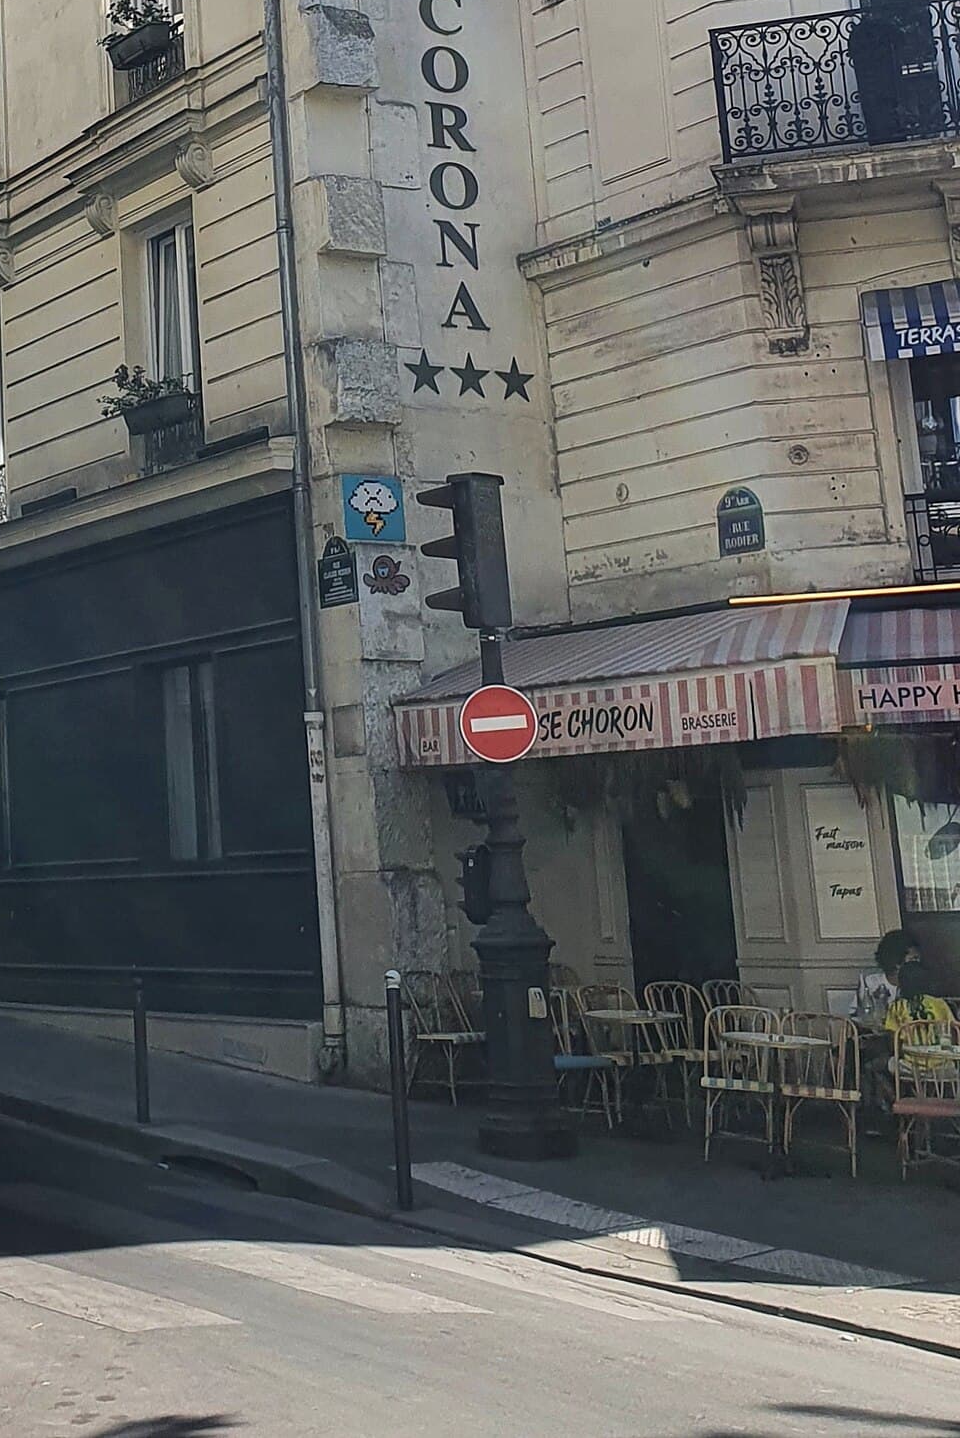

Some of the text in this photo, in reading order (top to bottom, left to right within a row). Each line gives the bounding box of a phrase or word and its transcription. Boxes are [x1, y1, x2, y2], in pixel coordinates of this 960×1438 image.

[732, 520, 751, 534] RUE
[724, 533, 760, 550] RODIER
[858, 685, 942, 710] HAPPY
[567, 700, 654, 739] CHORON
[681, 712, 737, 731] BRASSERIE
[422, 740, 438, 753] BAR
[815, 826, 840, 841] Fait
[826, 839, 865, 851] maison
[829, 884, 862, 899] Tapas
